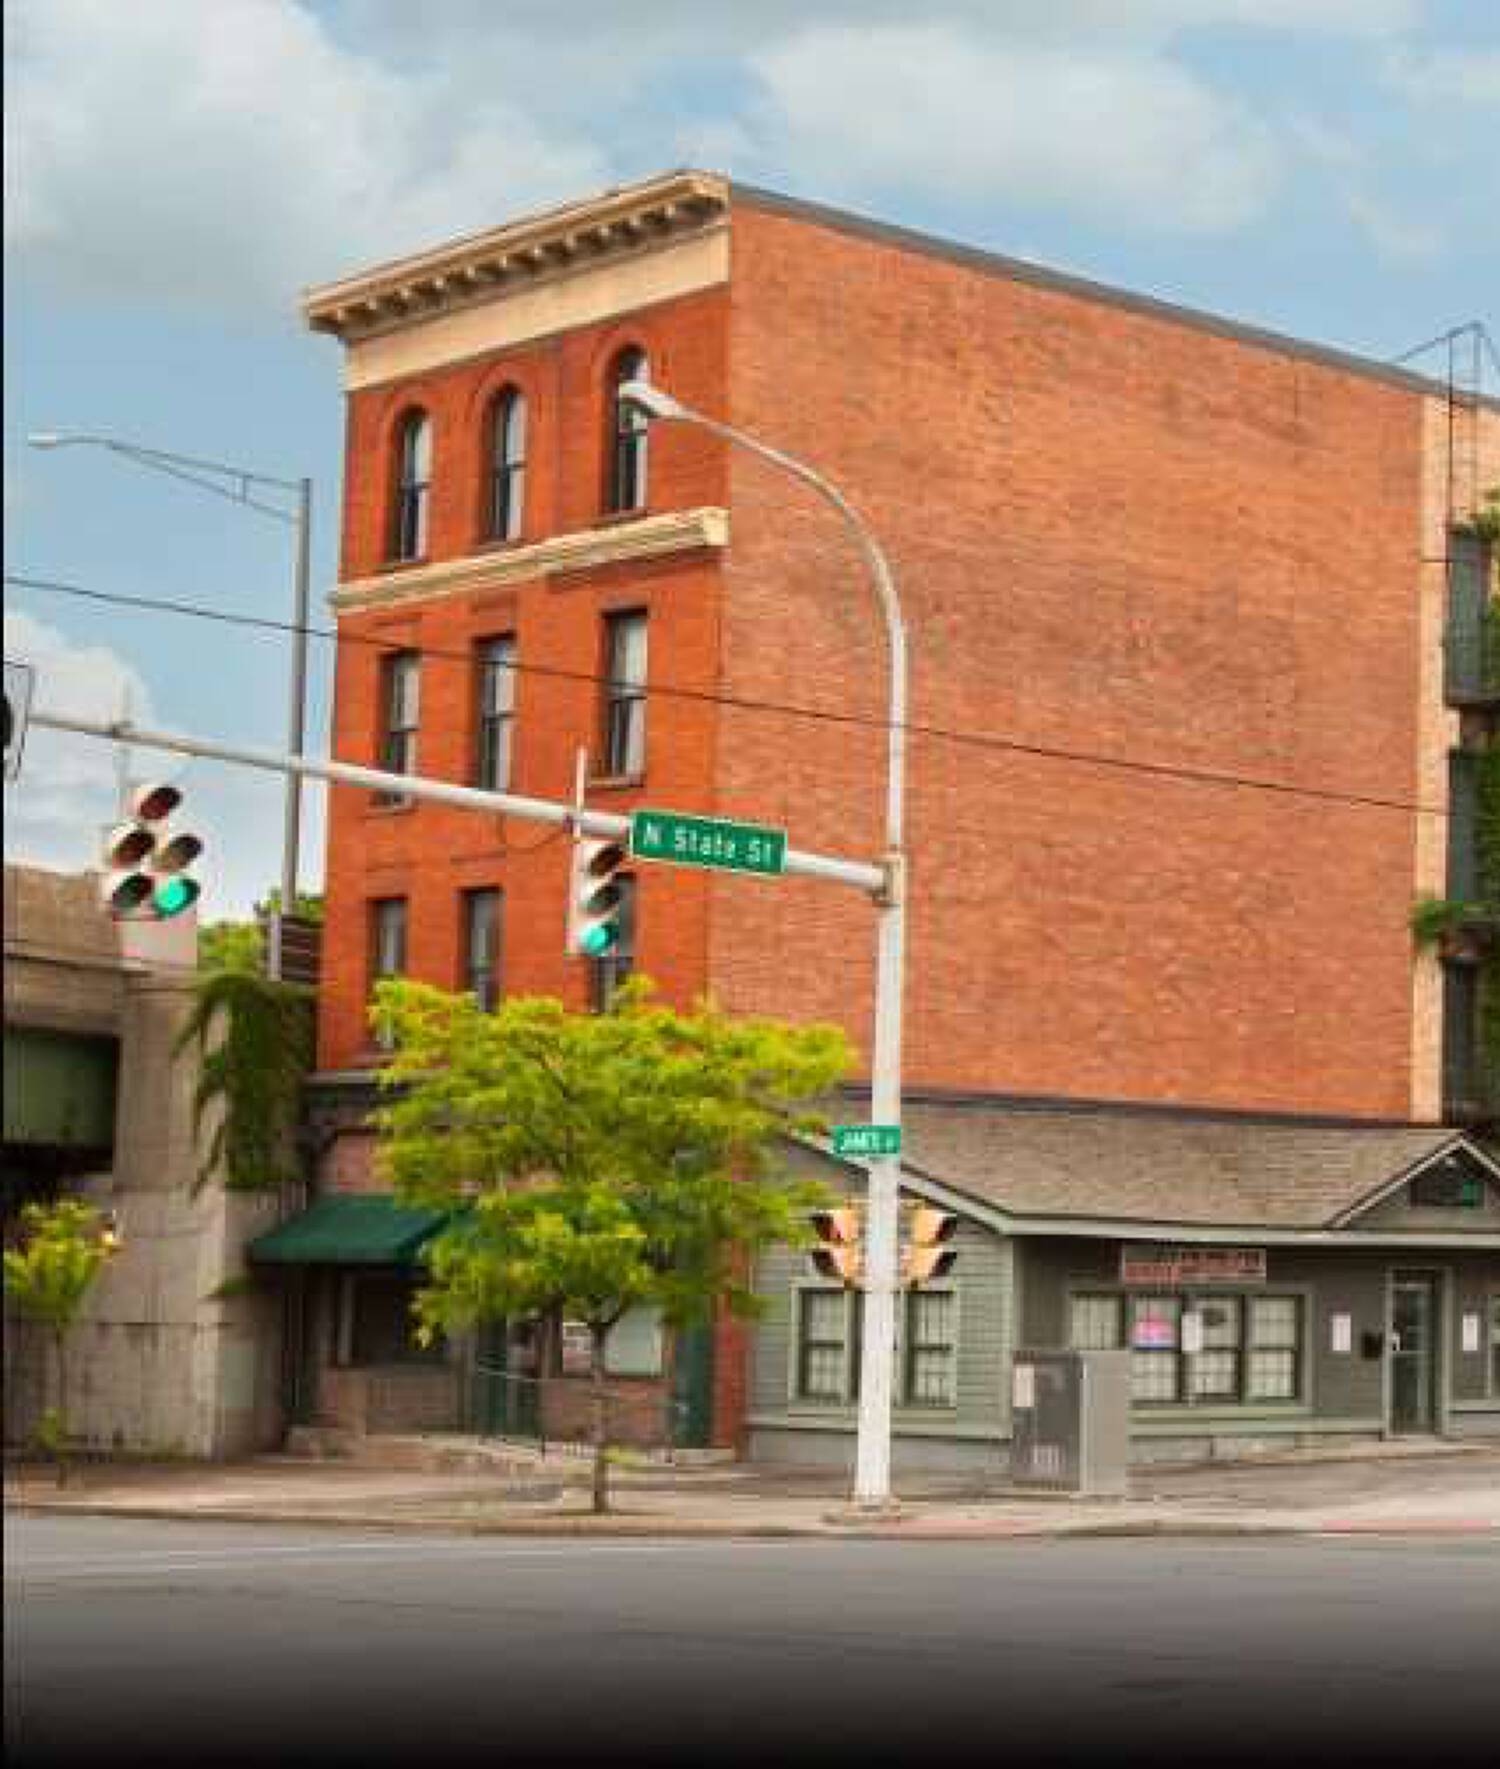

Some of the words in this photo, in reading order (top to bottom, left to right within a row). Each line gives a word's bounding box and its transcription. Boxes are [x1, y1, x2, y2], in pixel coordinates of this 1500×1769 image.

[642, 821, 662, 848] N
[674, 825, 737, 860] State
[745, 835, 773, 866] St
